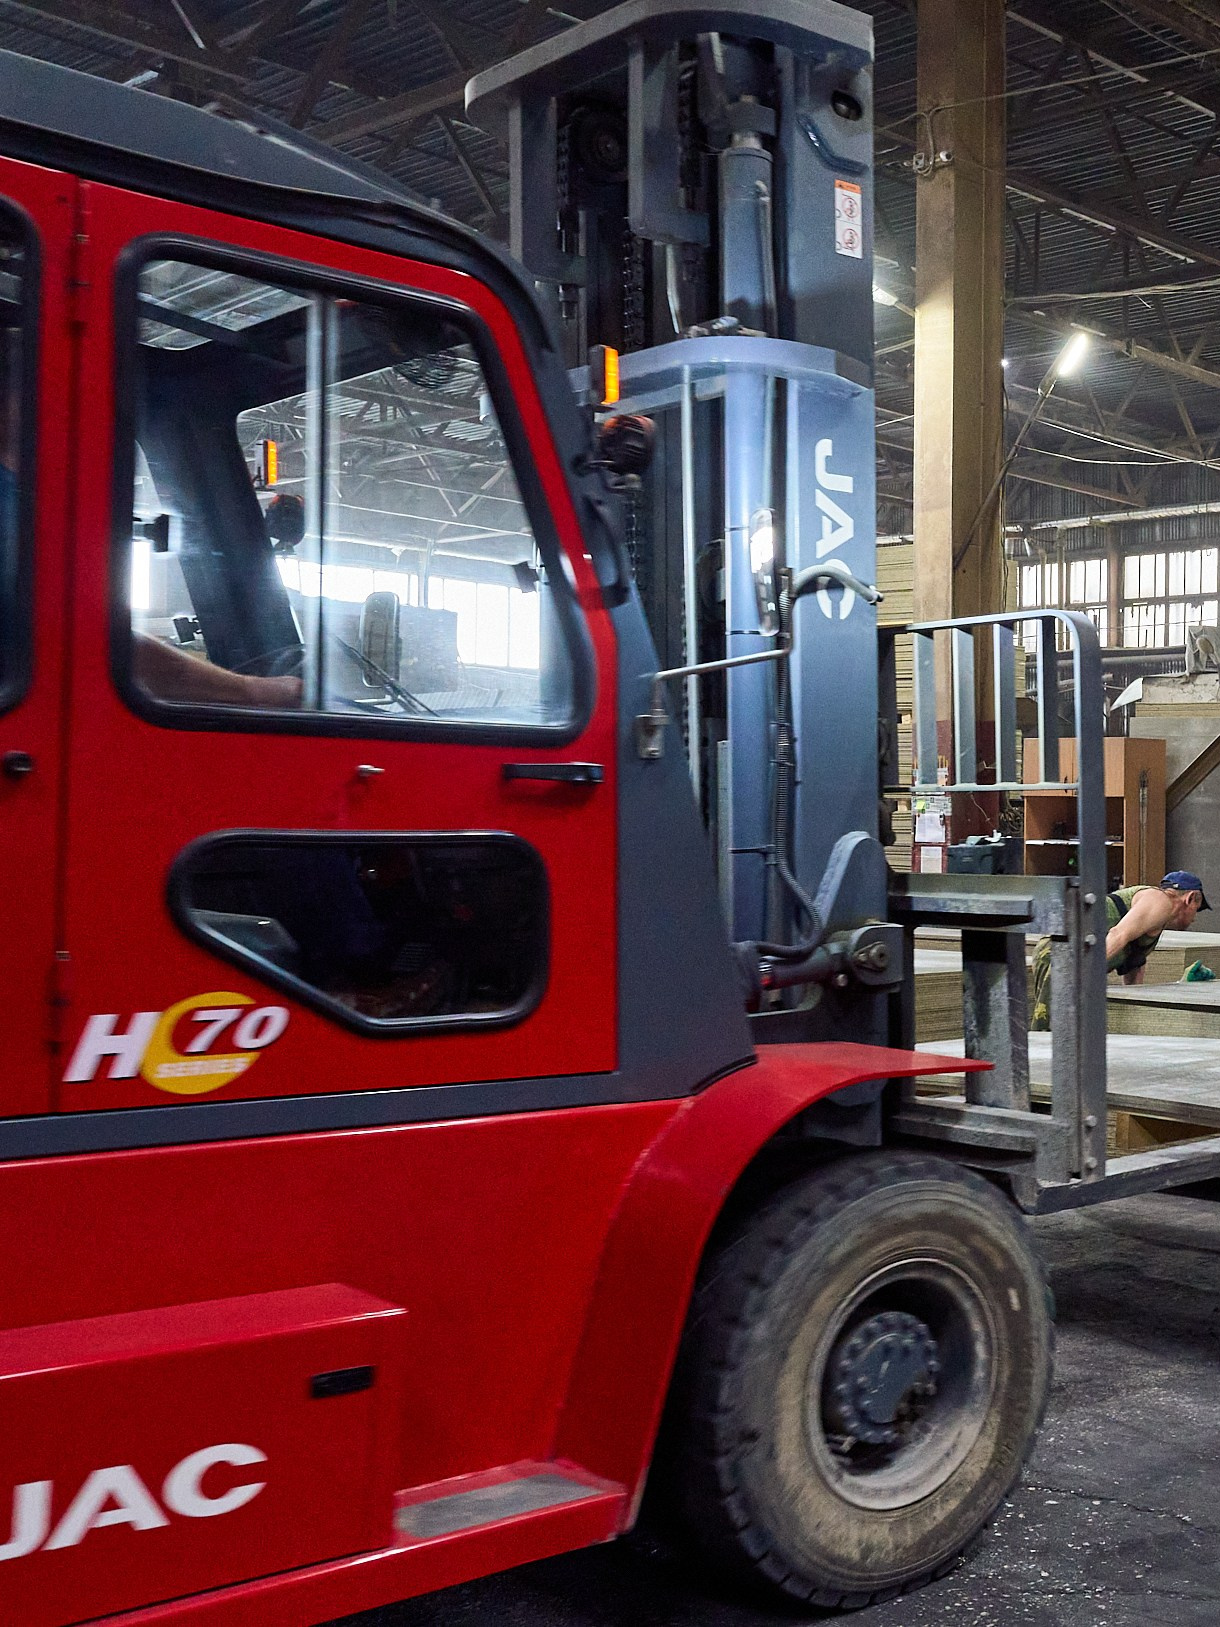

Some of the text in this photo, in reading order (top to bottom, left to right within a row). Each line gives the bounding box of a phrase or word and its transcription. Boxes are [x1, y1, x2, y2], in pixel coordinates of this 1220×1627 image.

[815, 438, 855, 620] JAC
[184, 1005, 291, 1053] 70
[0, 1443, 268, 1562] JAC
